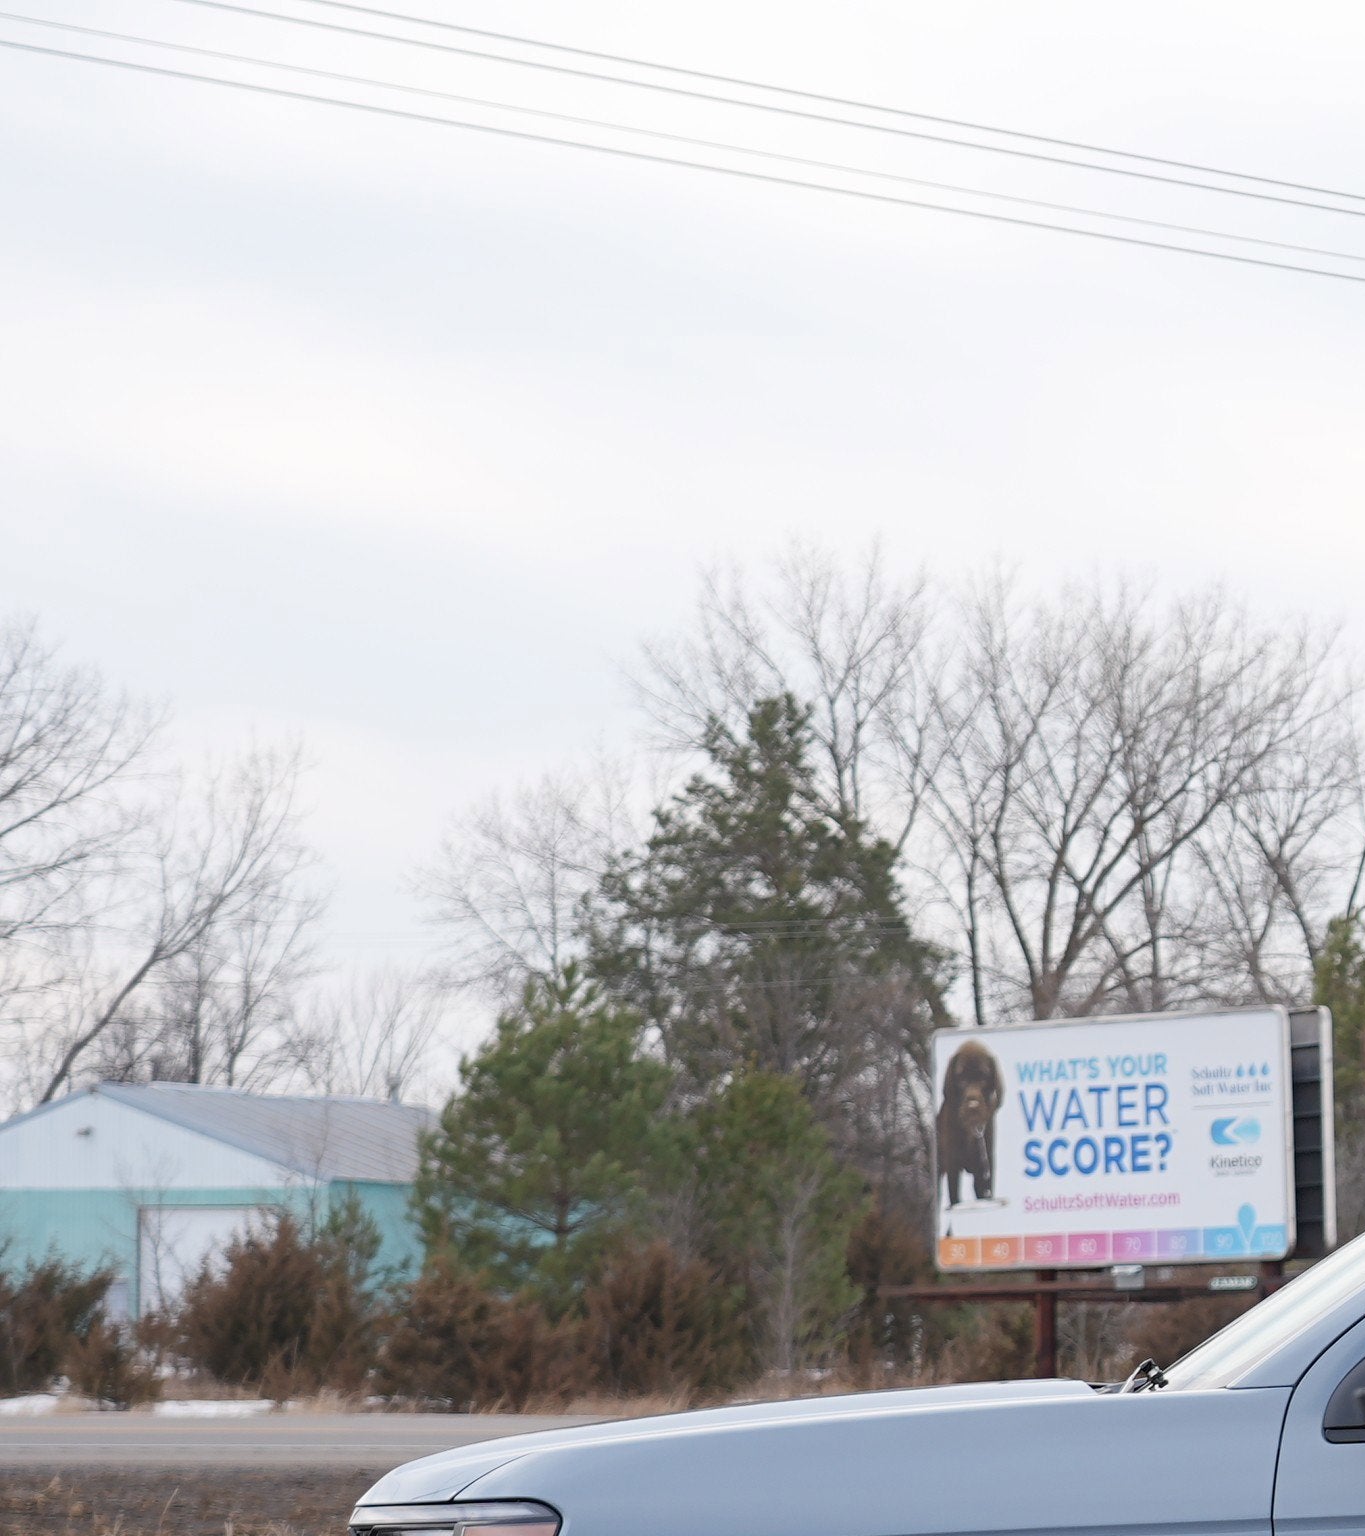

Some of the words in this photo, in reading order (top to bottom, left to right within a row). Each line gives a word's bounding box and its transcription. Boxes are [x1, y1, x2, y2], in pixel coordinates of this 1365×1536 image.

[1016, 1056, 1100, 1082] WHAT'S
[1106, 1052, 1168, 1077] YOUR
[1191, 1065, 1232, 1079] Schultz
[1018, 1082, 1170, 1132] WATER
[1023, 1132, 1173, 1178] SCORE?
[1210, 1154, 1262, 1169] Kinetico
[1023, 1191, 1181, 1213] SchultzSoftWater.com
[1124, 1236, 1142, 1252] 70
[1215, 1232, 1235, 1249] 90
